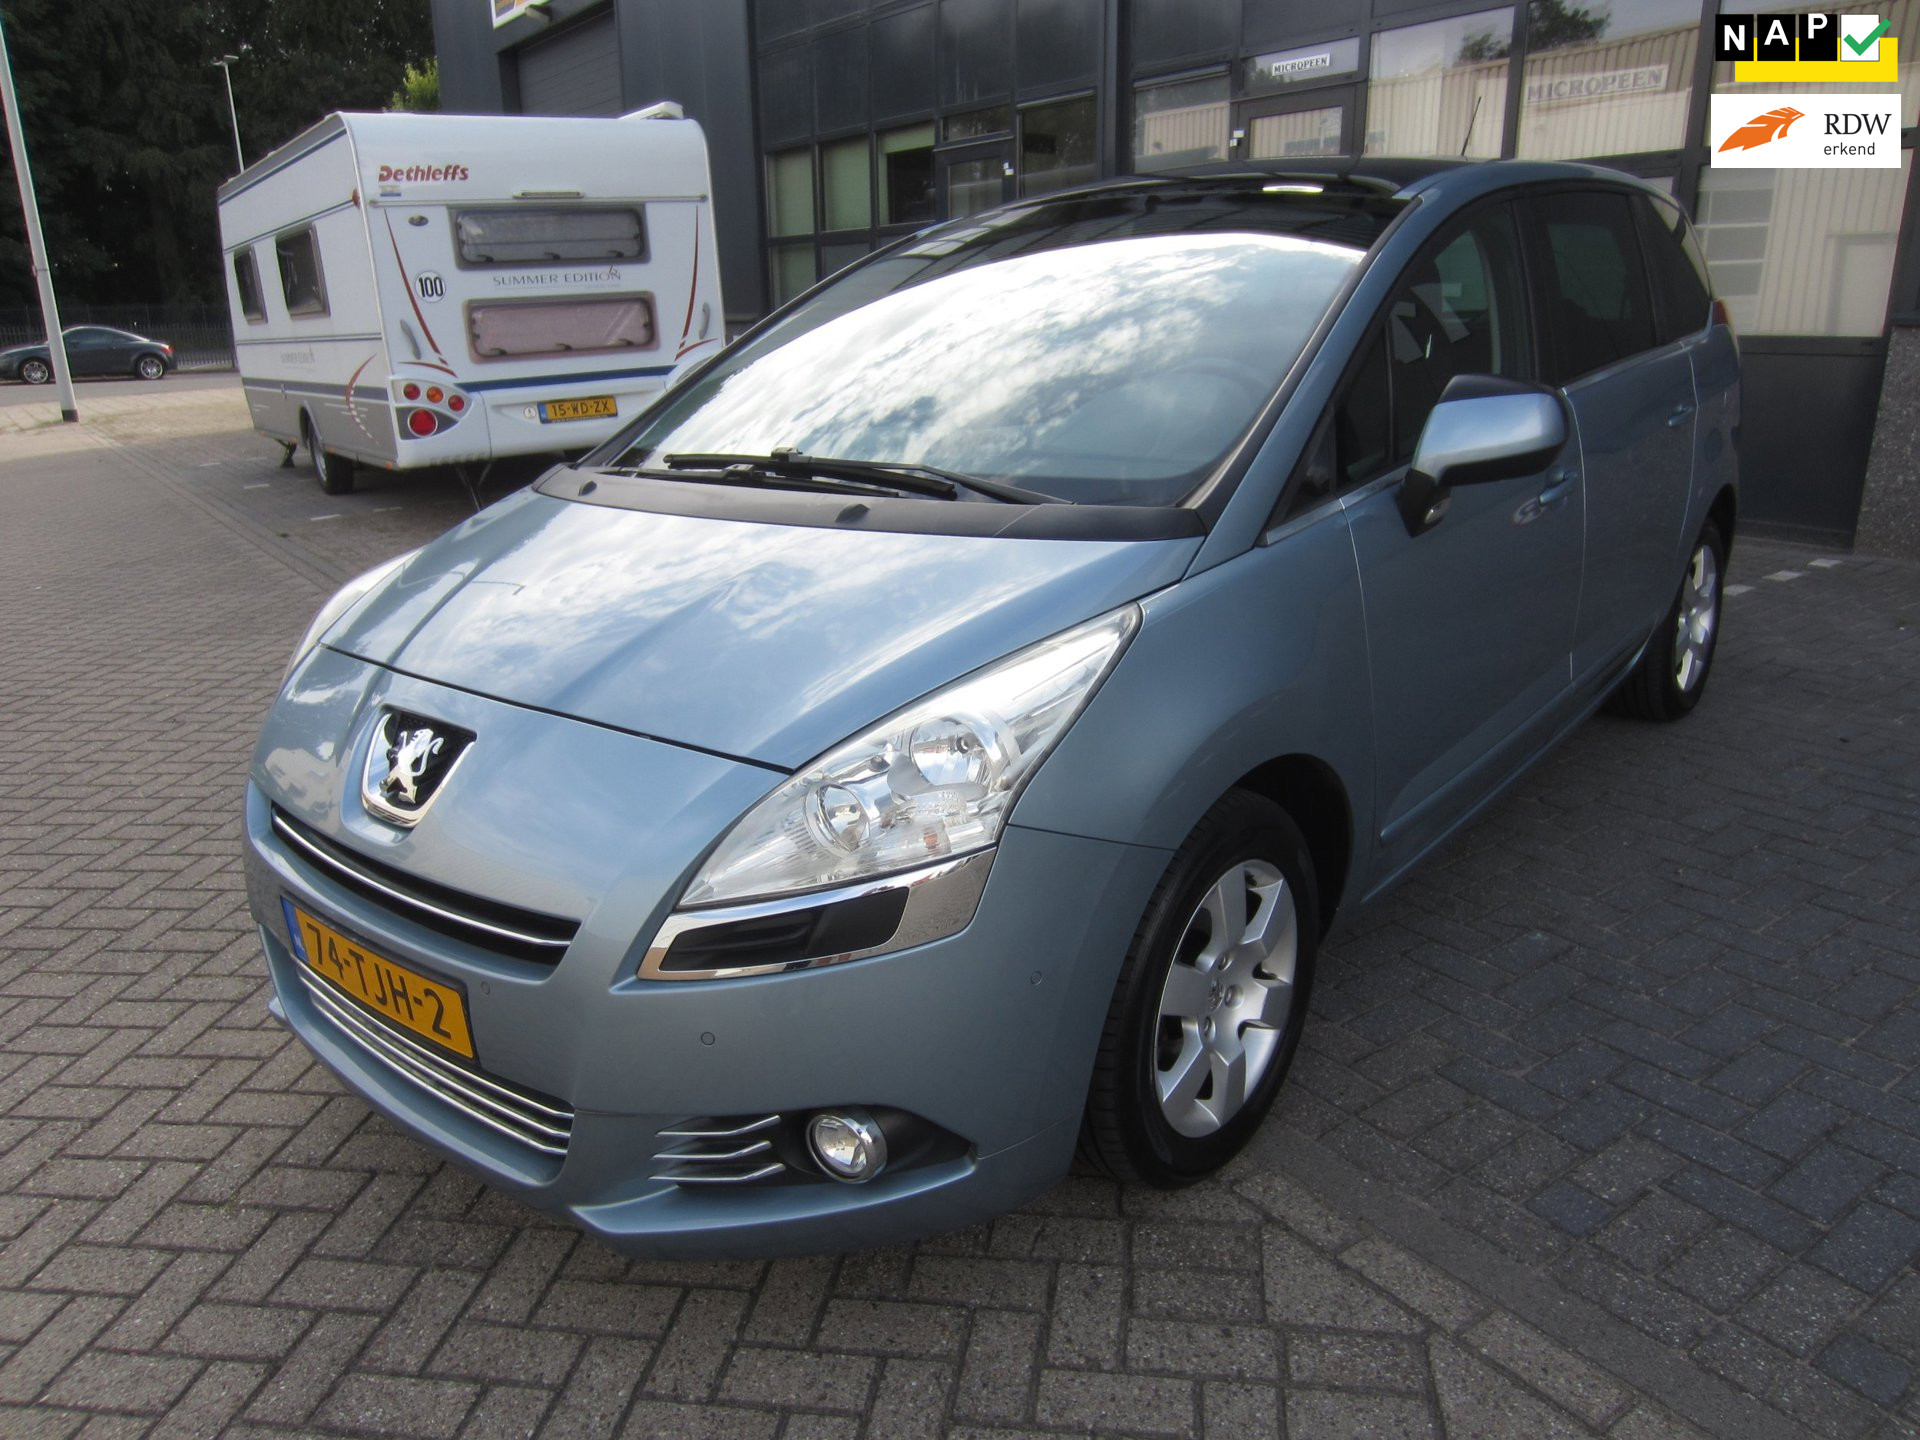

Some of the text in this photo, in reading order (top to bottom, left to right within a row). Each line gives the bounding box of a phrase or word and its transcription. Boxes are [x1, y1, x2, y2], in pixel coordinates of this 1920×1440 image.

[1274, 57, 1328, 73] MICROPEEN
[1528, 68, 1664, 102] MICROPEEN
[378, 164, 469, 182] Dethleffs
[418, 276, 444, 297] 100
[492, 270, 621, 286] SUMMER EDITION
[551, 400, 610, 417] 15-WD-ZX
[306, 922, 452, 1040] 74-TJH-2
